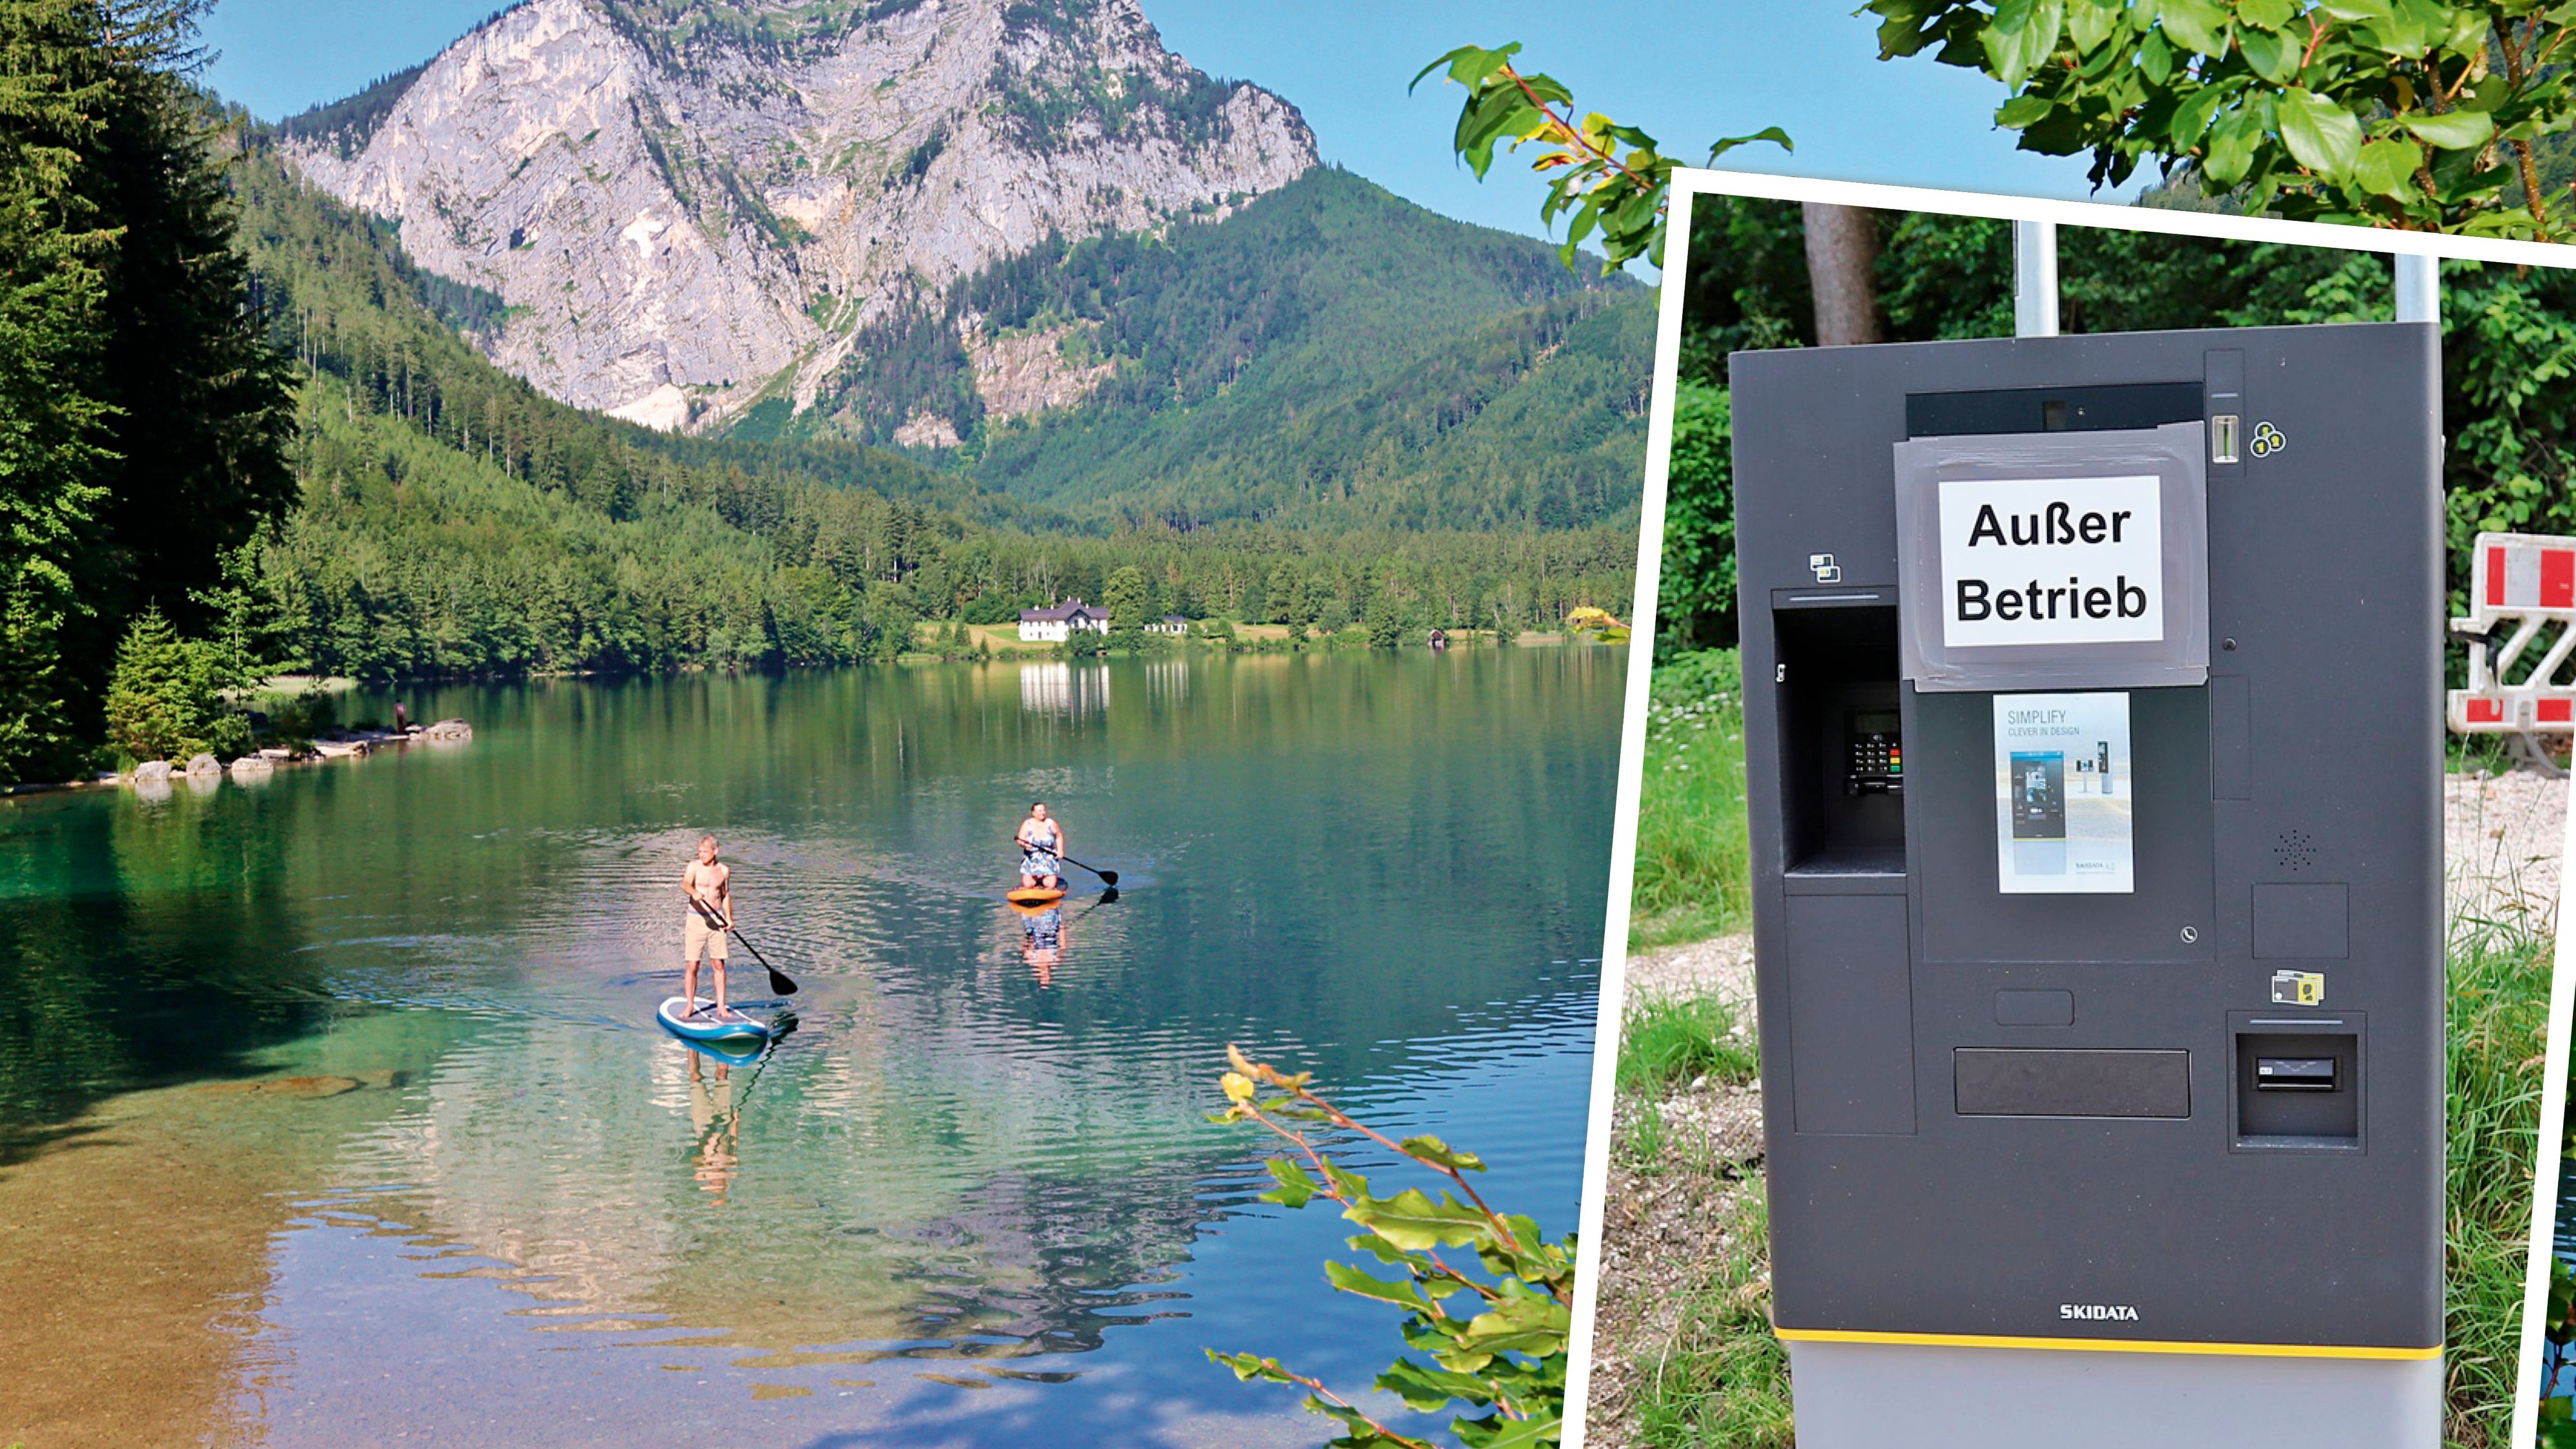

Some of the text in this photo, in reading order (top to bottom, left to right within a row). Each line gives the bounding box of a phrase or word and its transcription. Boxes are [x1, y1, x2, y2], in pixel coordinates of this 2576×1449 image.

[1968, 502, 2132, 547] Außer
[1957, 576, 2147, 621] Betrieb
[2008, 710, 2066, 724] SIMPLIFY
[2008, 726, 2079, 737] CLEVER IN DESIGN
[2060, 1304, 2139, 1321] SKIDATA
